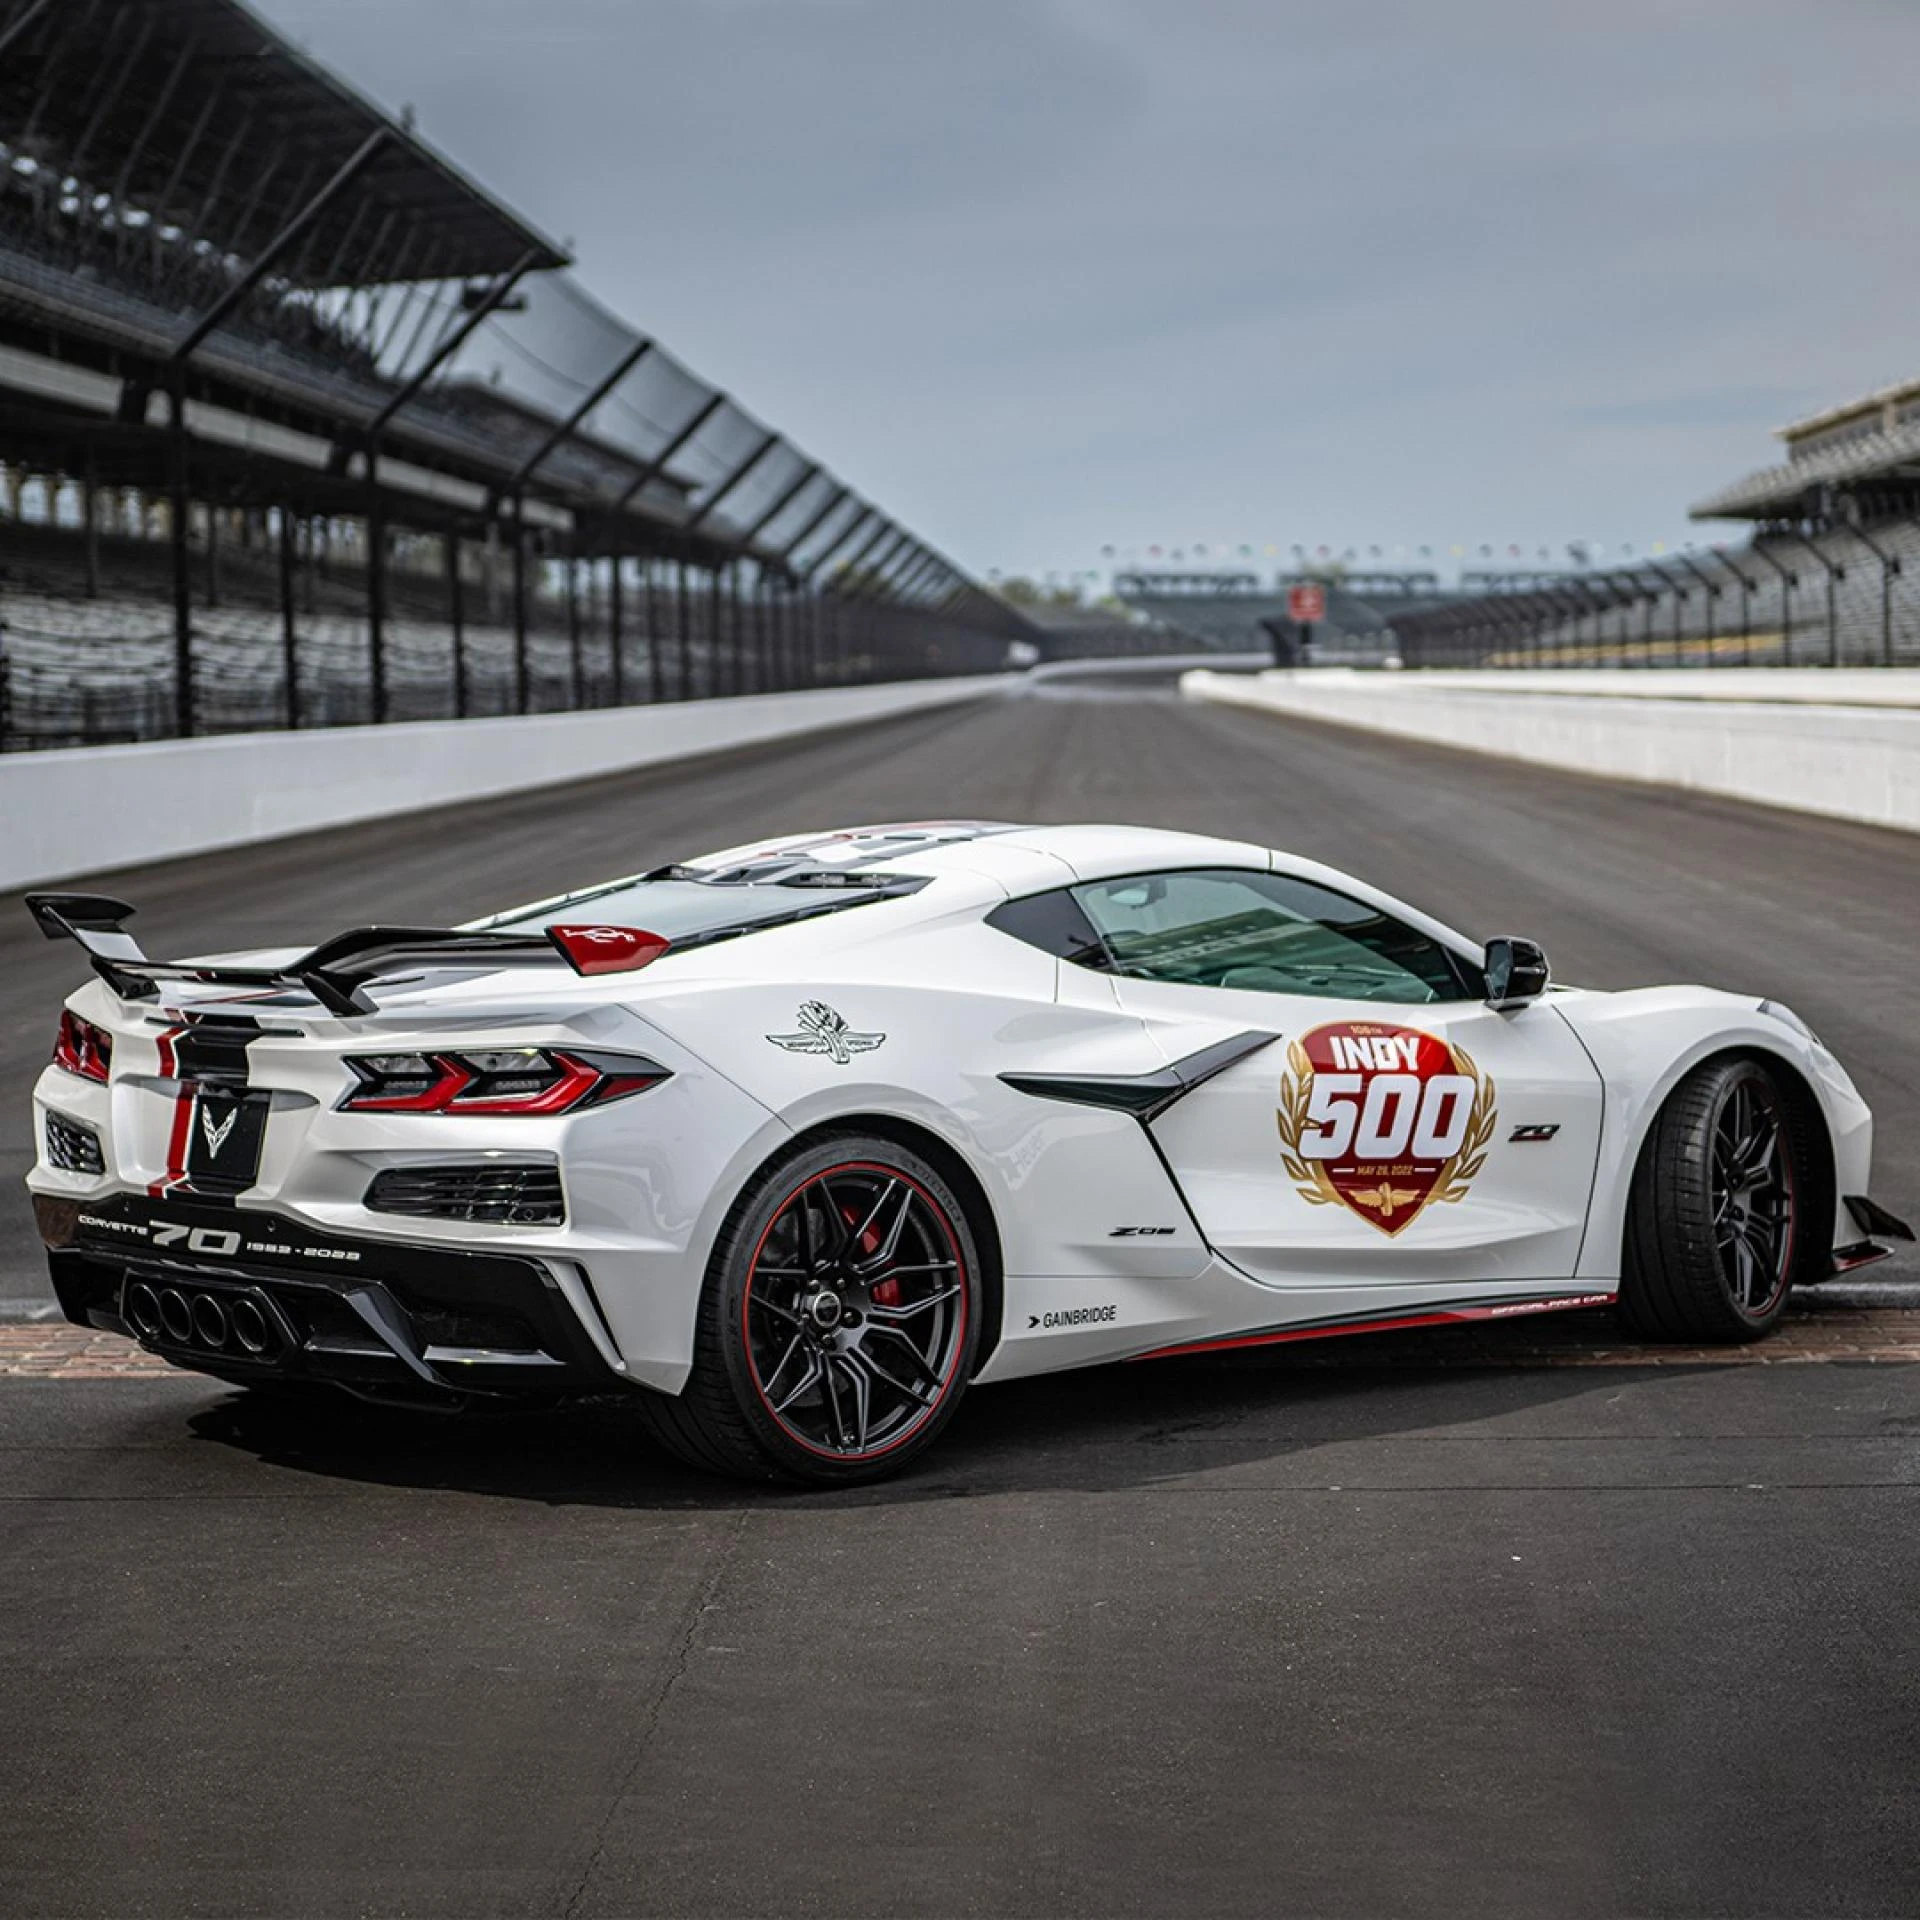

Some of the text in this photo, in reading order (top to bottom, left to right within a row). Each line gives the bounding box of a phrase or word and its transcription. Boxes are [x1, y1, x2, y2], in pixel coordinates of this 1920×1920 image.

[1329, 1035, 1420, 1071] INDY
[1299, 1073, 1476, 1160] 500
[1356, 1165, 1376, 1176] MAY
[78, 1214, 148, 1235] CORVETTE
[149, 1220, 241, 1256] 70
[1043, 1305, 1117, 1328] GAINBRIDGE
